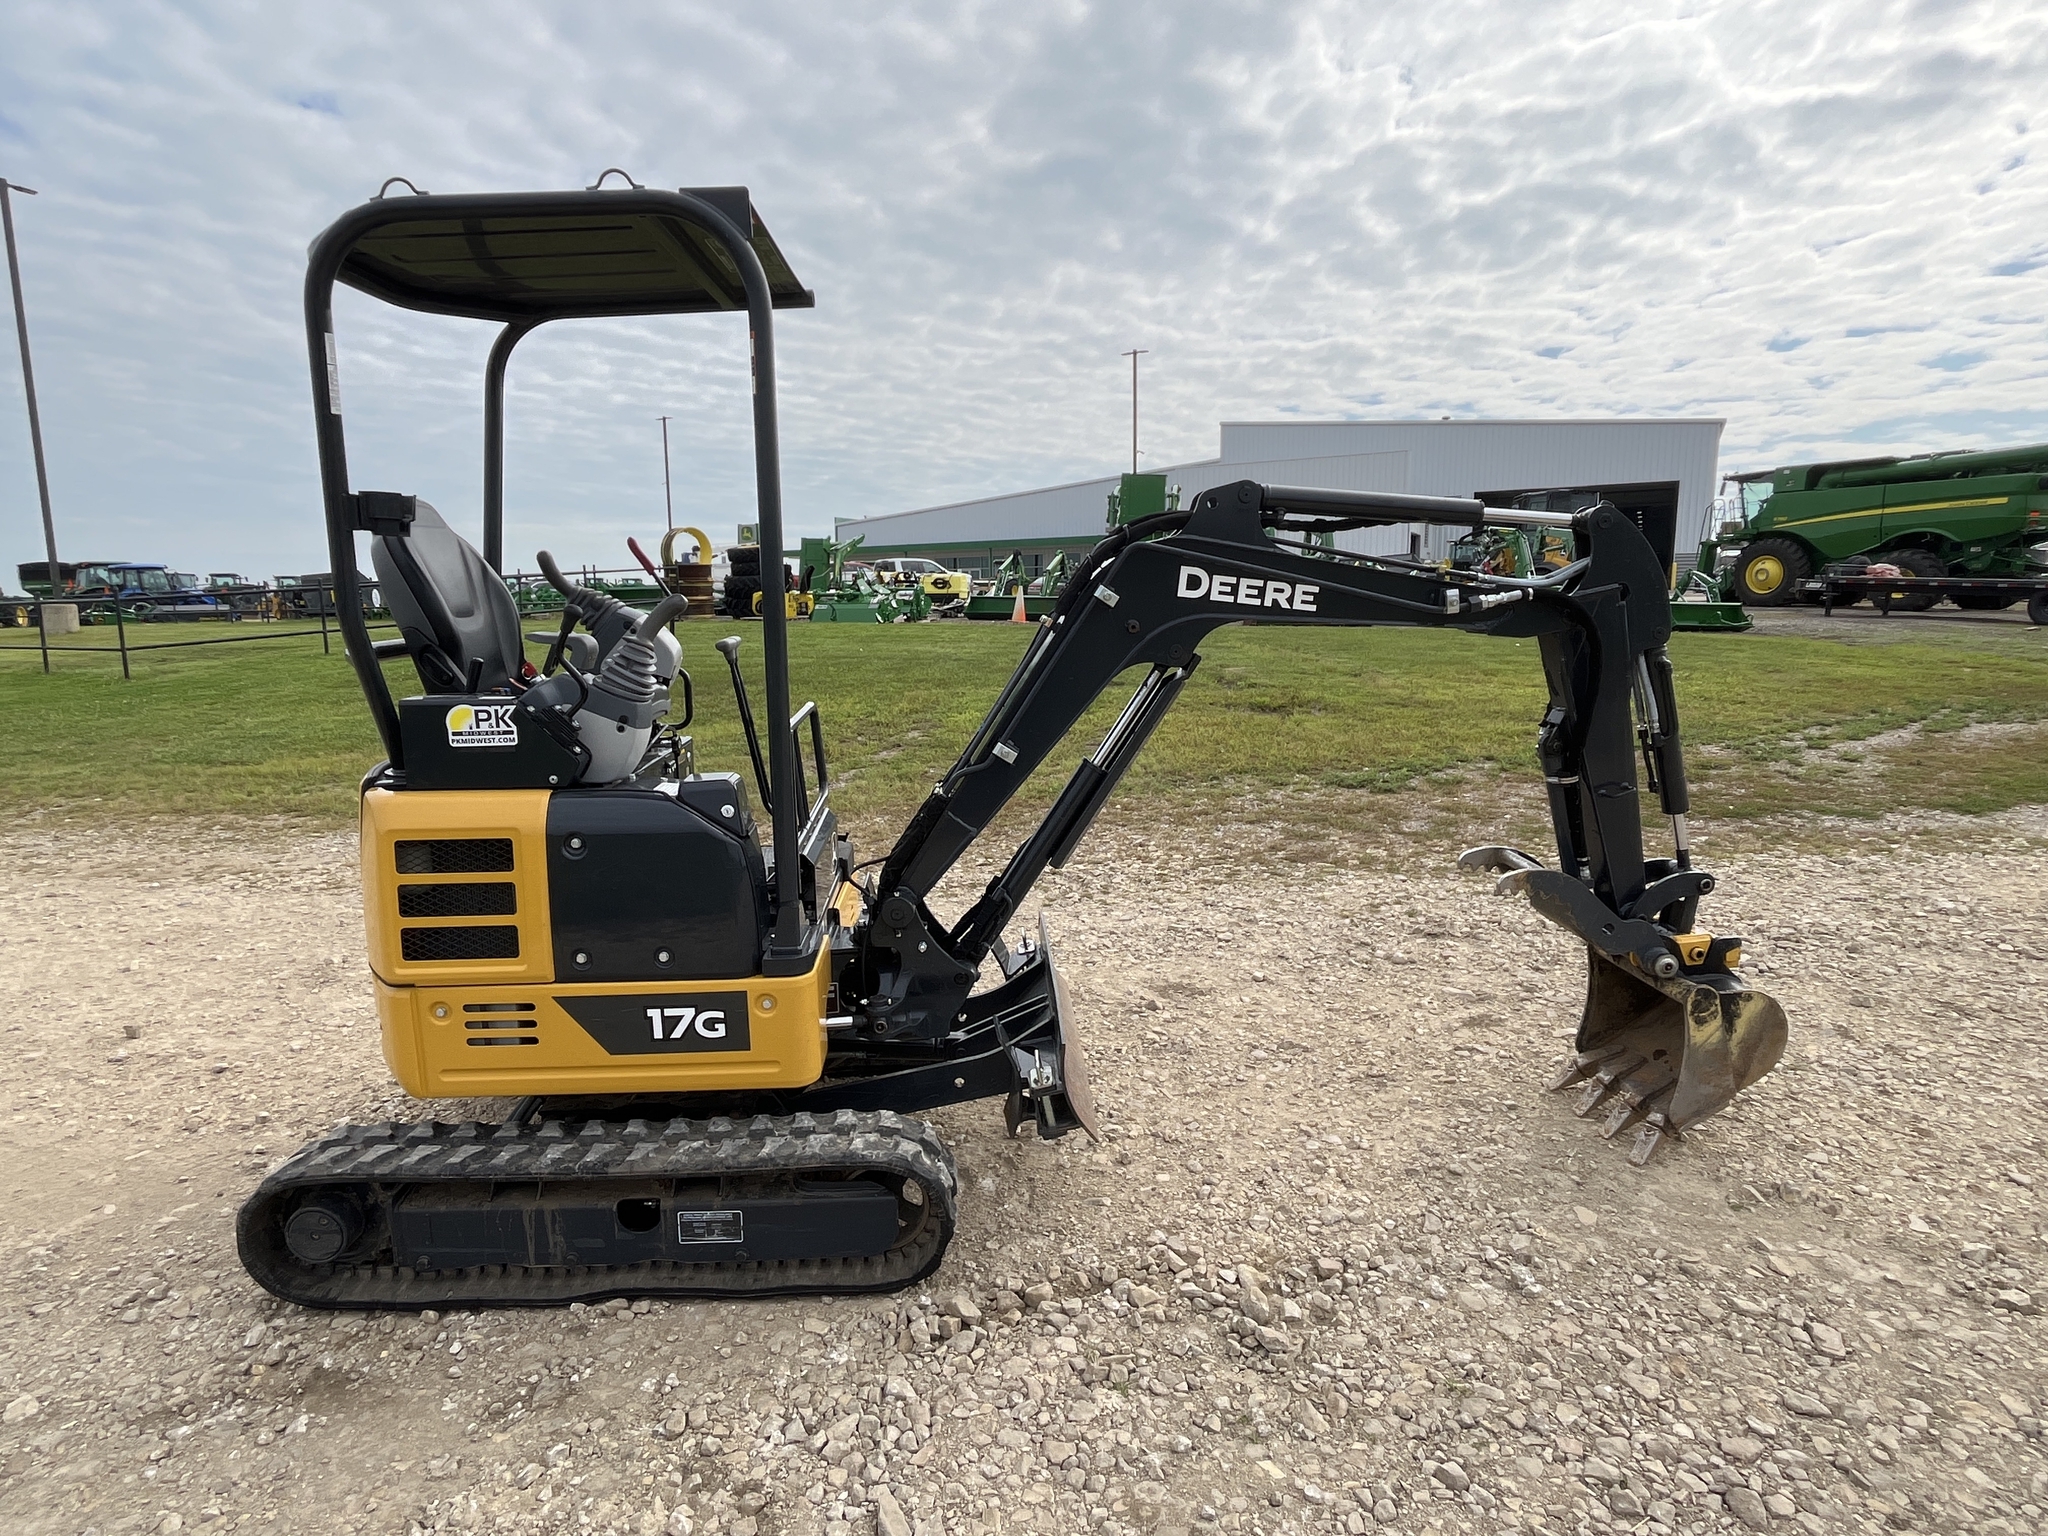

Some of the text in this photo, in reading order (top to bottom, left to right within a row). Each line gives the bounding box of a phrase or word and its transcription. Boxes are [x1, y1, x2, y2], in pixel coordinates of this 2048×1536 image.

[1177, 565, 1320, 612] DEERE
[451, 737, 516, 745] PKMIDWEST.COM
[646, 1007, 727, 1040] 17G
